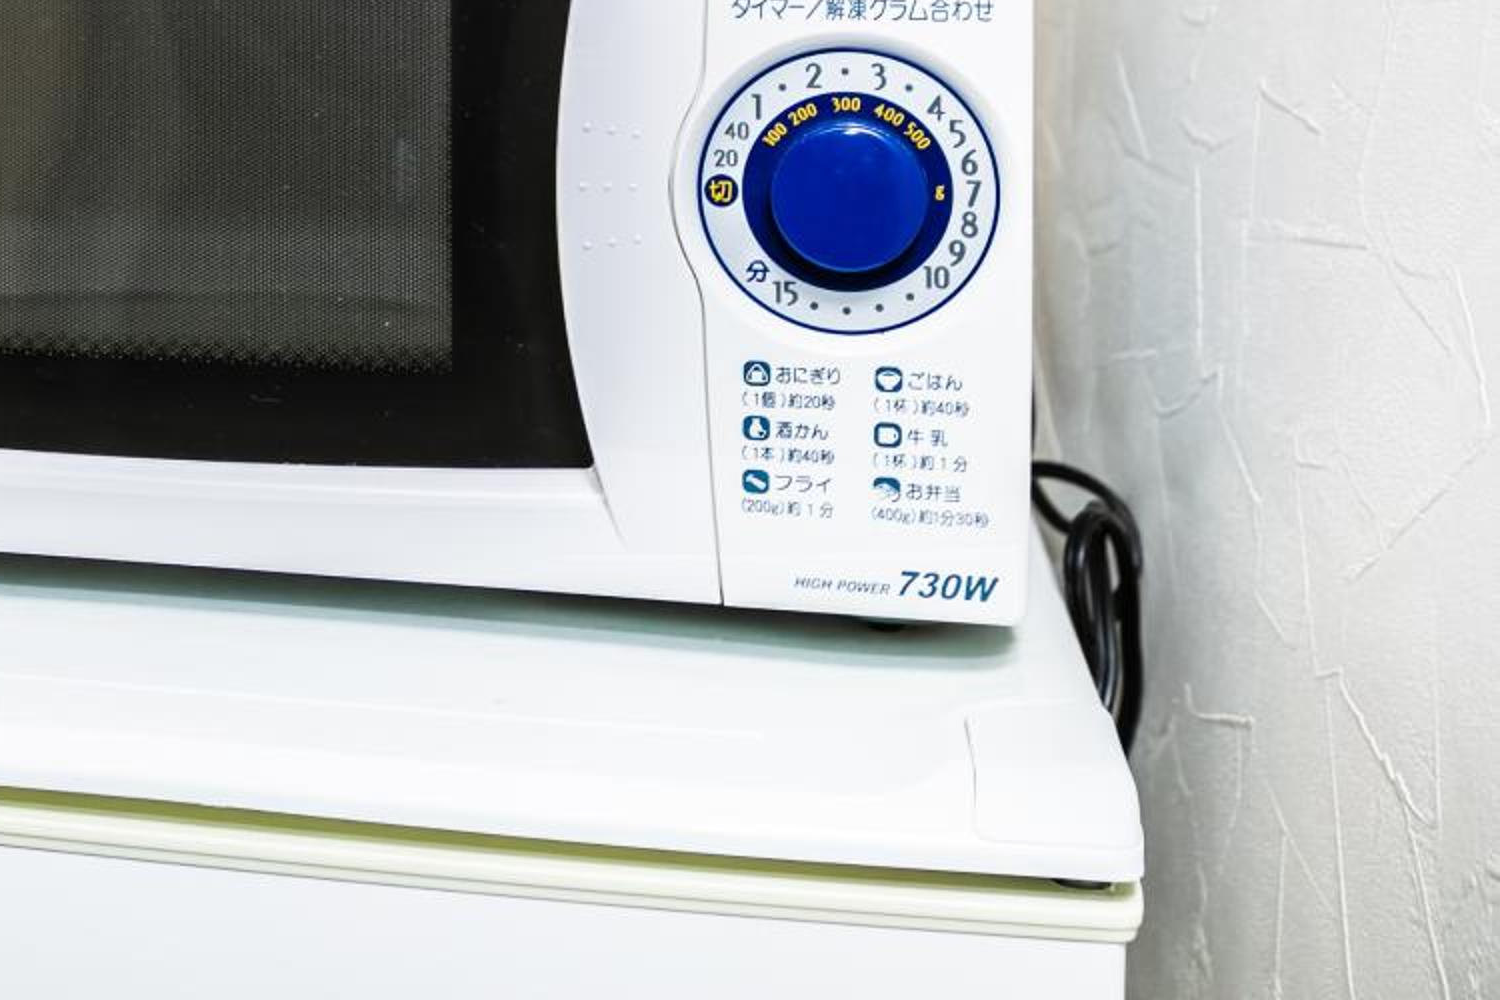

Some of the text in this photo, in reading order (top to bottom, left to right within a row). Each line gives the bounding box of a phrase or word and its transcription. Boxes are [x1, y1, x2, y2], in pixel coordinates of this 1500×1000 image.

[762, 123, 788, 148] 100
[788, 103, 818, 127] 200
[831, 97, 861, 112] 300
[873, 103, 905, 127] 400
[904, 122, 931, 150] 500
[709, 63, 982, 306] 切 20 40 1 2 3 4 5 6 7 8 9 10 15 分
[776, 367, 841, 384] おにぎり
[908, 372, 963, 391] ごはん
[775, 421, 829, 440] 酒かん
[907, 428, 948, 447] 牛乳
[775, 475, 831, 495] フライ
[906, 483, 961, 502] お弁当
[794, 571, 999, 602] HIGH POWER 730W
